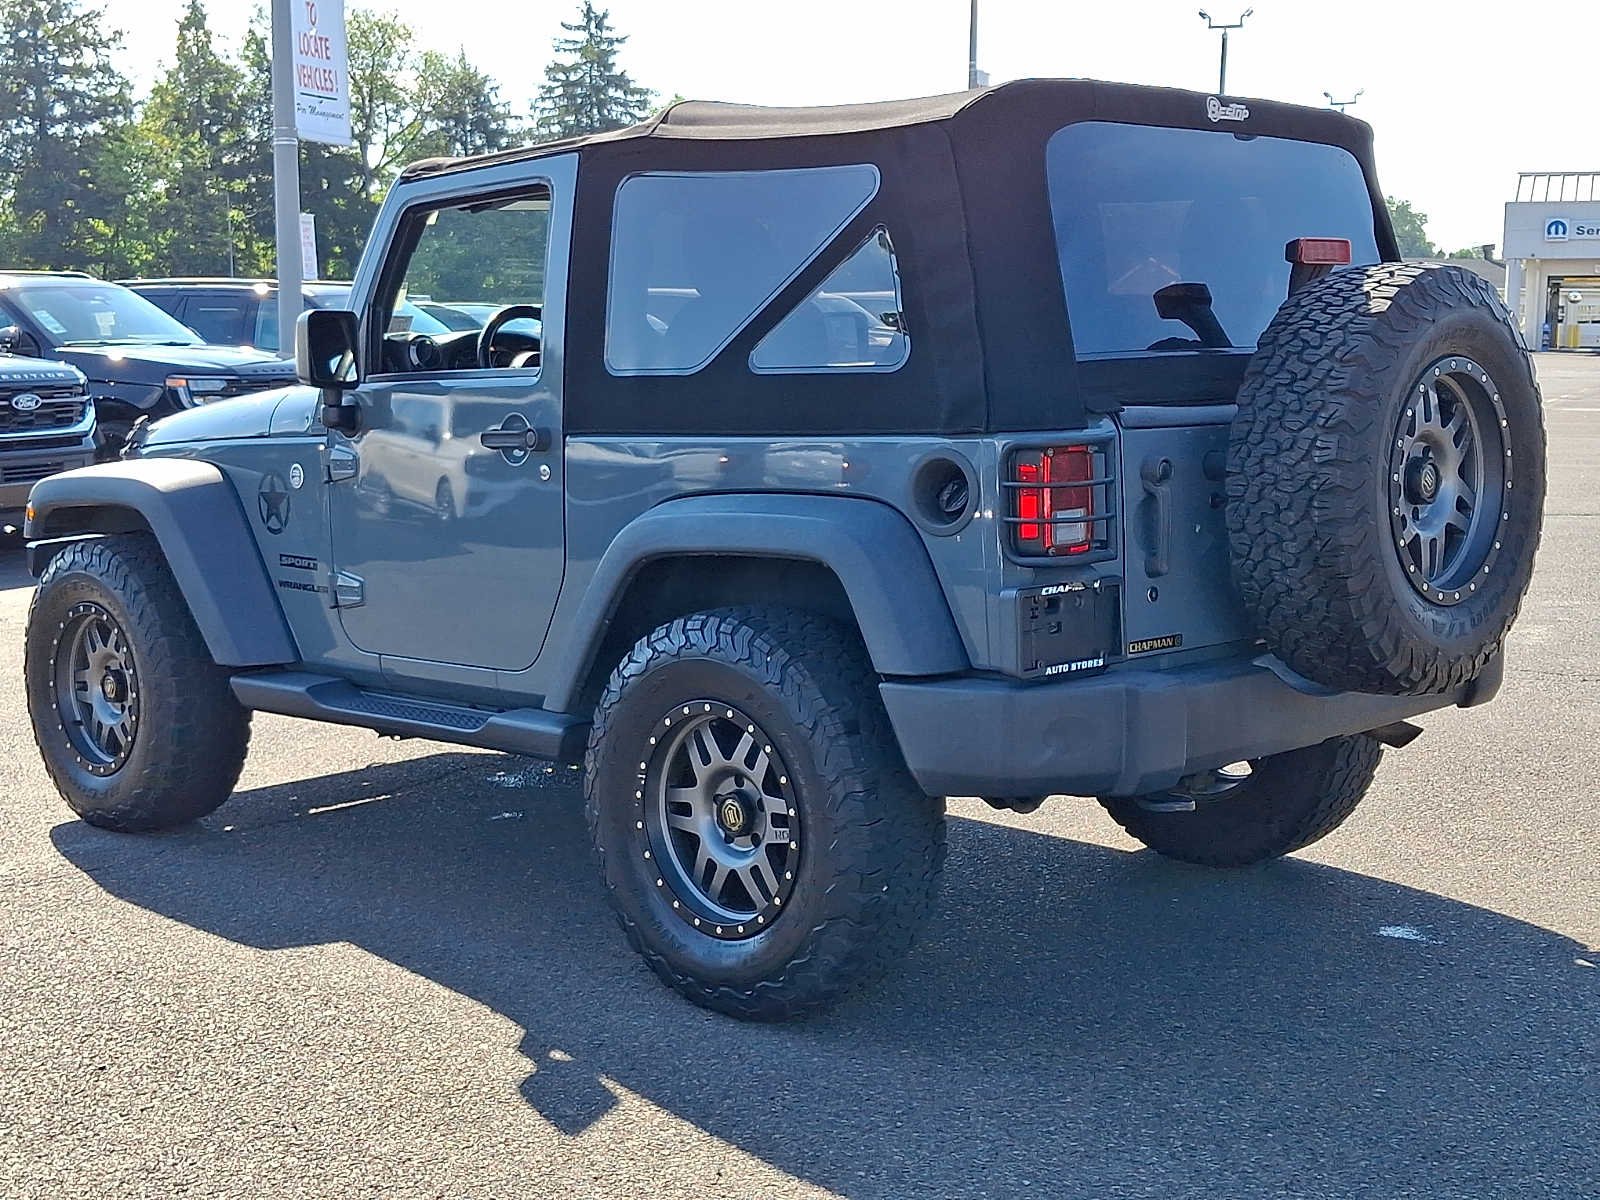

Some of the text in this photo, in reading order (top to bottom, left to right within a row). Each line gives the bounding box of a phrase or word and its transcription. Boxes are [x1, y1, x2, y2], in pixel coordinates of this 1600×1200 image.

[298, 32, 331, 60] LOCATE
[280, 555, 318, 570] SPORT
[1129, 637, 1174, 653] CHAPMAN
[1045, 658, 1104, 676] AUTO STORES
